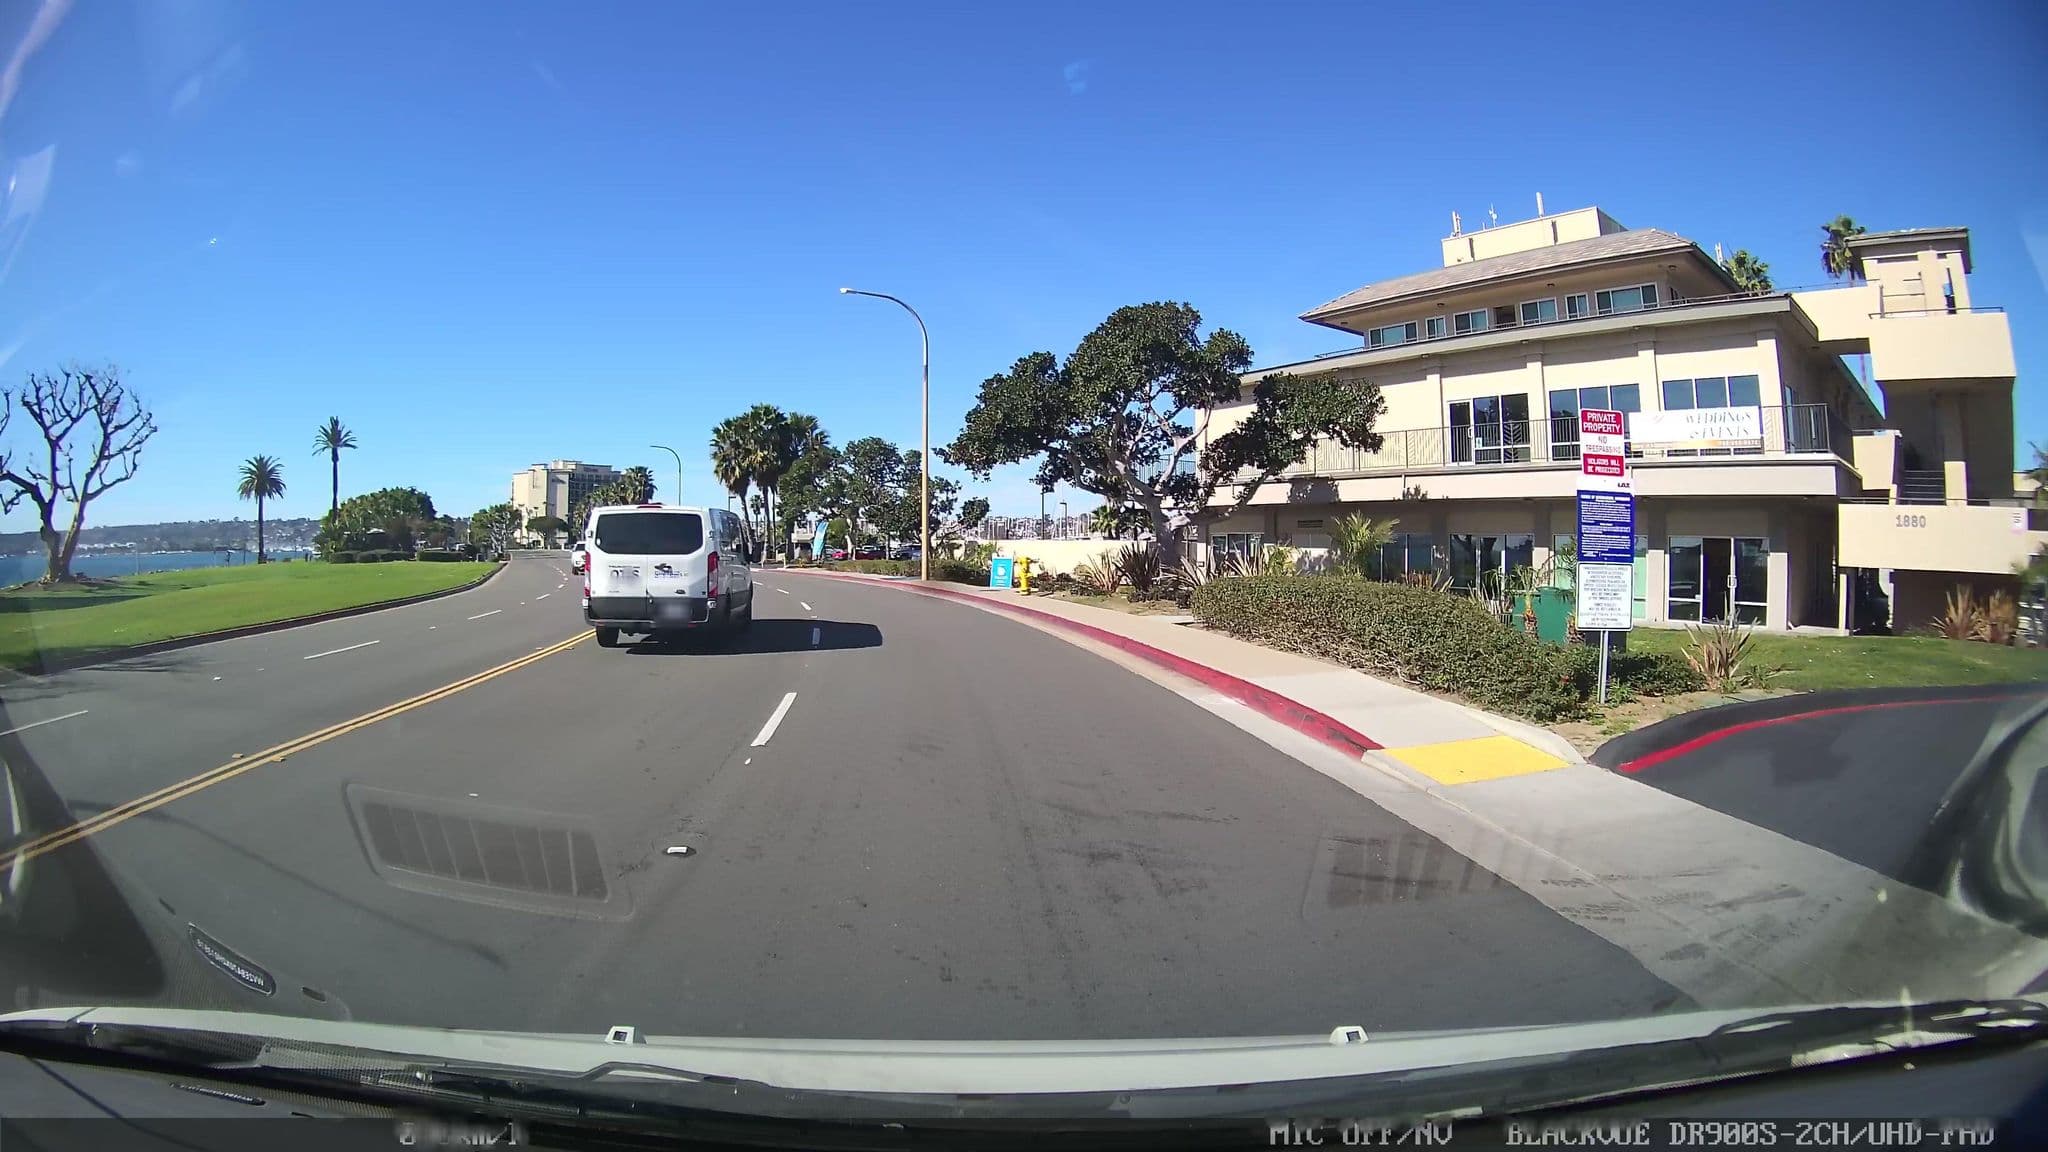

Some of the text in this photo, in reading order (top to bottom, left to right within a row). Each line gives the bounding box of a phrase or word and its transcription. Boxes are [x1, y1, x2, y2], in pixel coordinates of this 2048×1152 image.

[1587, 412, 1617, 423] PRIVATE
[1686, 411, 1752, 424] WEDDINGS
[1583, 422, 1621, 433] PROPERTY
[1598, 436, 1608, 444] NO
[1585, 444, 1622, 454] TRESPASSING
[1895, 514, 1927, 528] 1880
